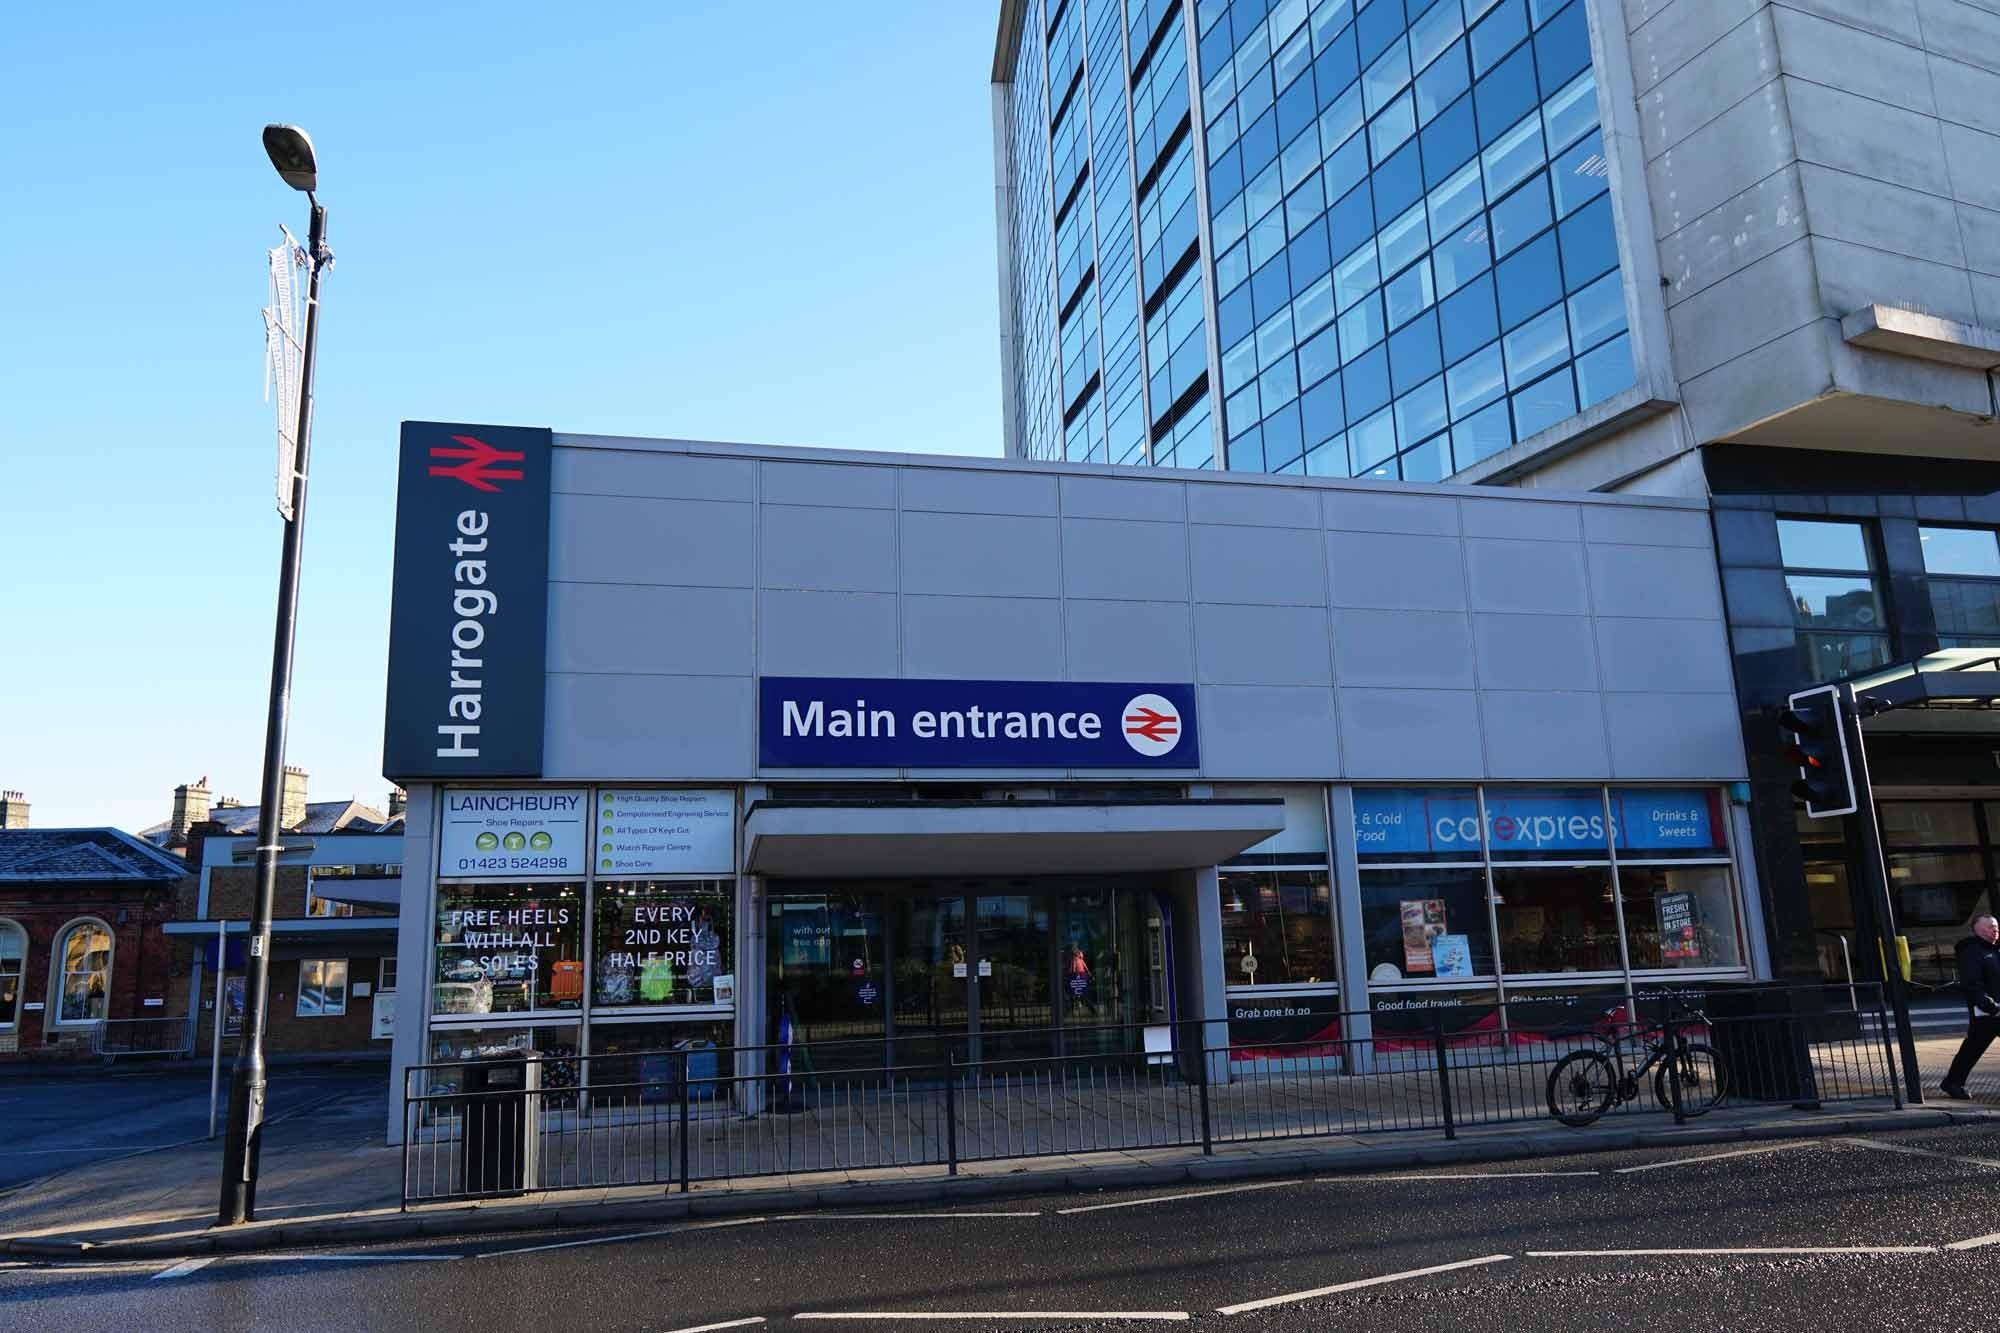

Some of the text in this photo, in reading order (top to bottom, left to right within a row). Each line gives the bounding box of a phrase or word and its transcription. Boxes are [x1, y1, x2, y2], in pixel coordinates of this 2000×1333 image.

[437, 510, 498, 758] Harrogate
[782, 699, 1102, 739] Main entrance
[450, 795, 580, 811] LAINCHBURY
[486, 818, 544, 828] Shoe Repairs
[1375, 811, 1402, 825] Cold
[1652, 809, 1687, 822] Drinks
[1356, 829, 1386, 841] Food
[1658, 825, 1697, 837] Sweets
[459, 857, 568, 870] 01423 524298
[451, 908, 569, 927] FREE HEELS
[635, 906, 696, 922] EVERY
[625, 928, 703, 945] 2ND KEY
[792, 927, 813, 935] with
[464, 931, 556, 949] WITH ALL
[479, 954, 539, 972] SOLES
[610, 949, 717, 968] HALF PRICE
[1376, 1000, 1404, 1011] Good
[1405, 999, 1428, 1009] food
[1235, 1007, 1261, 1019] Grab
[1263, 1008, 1282, 1017] one
[1284, 1007, 1295, 1017] to
